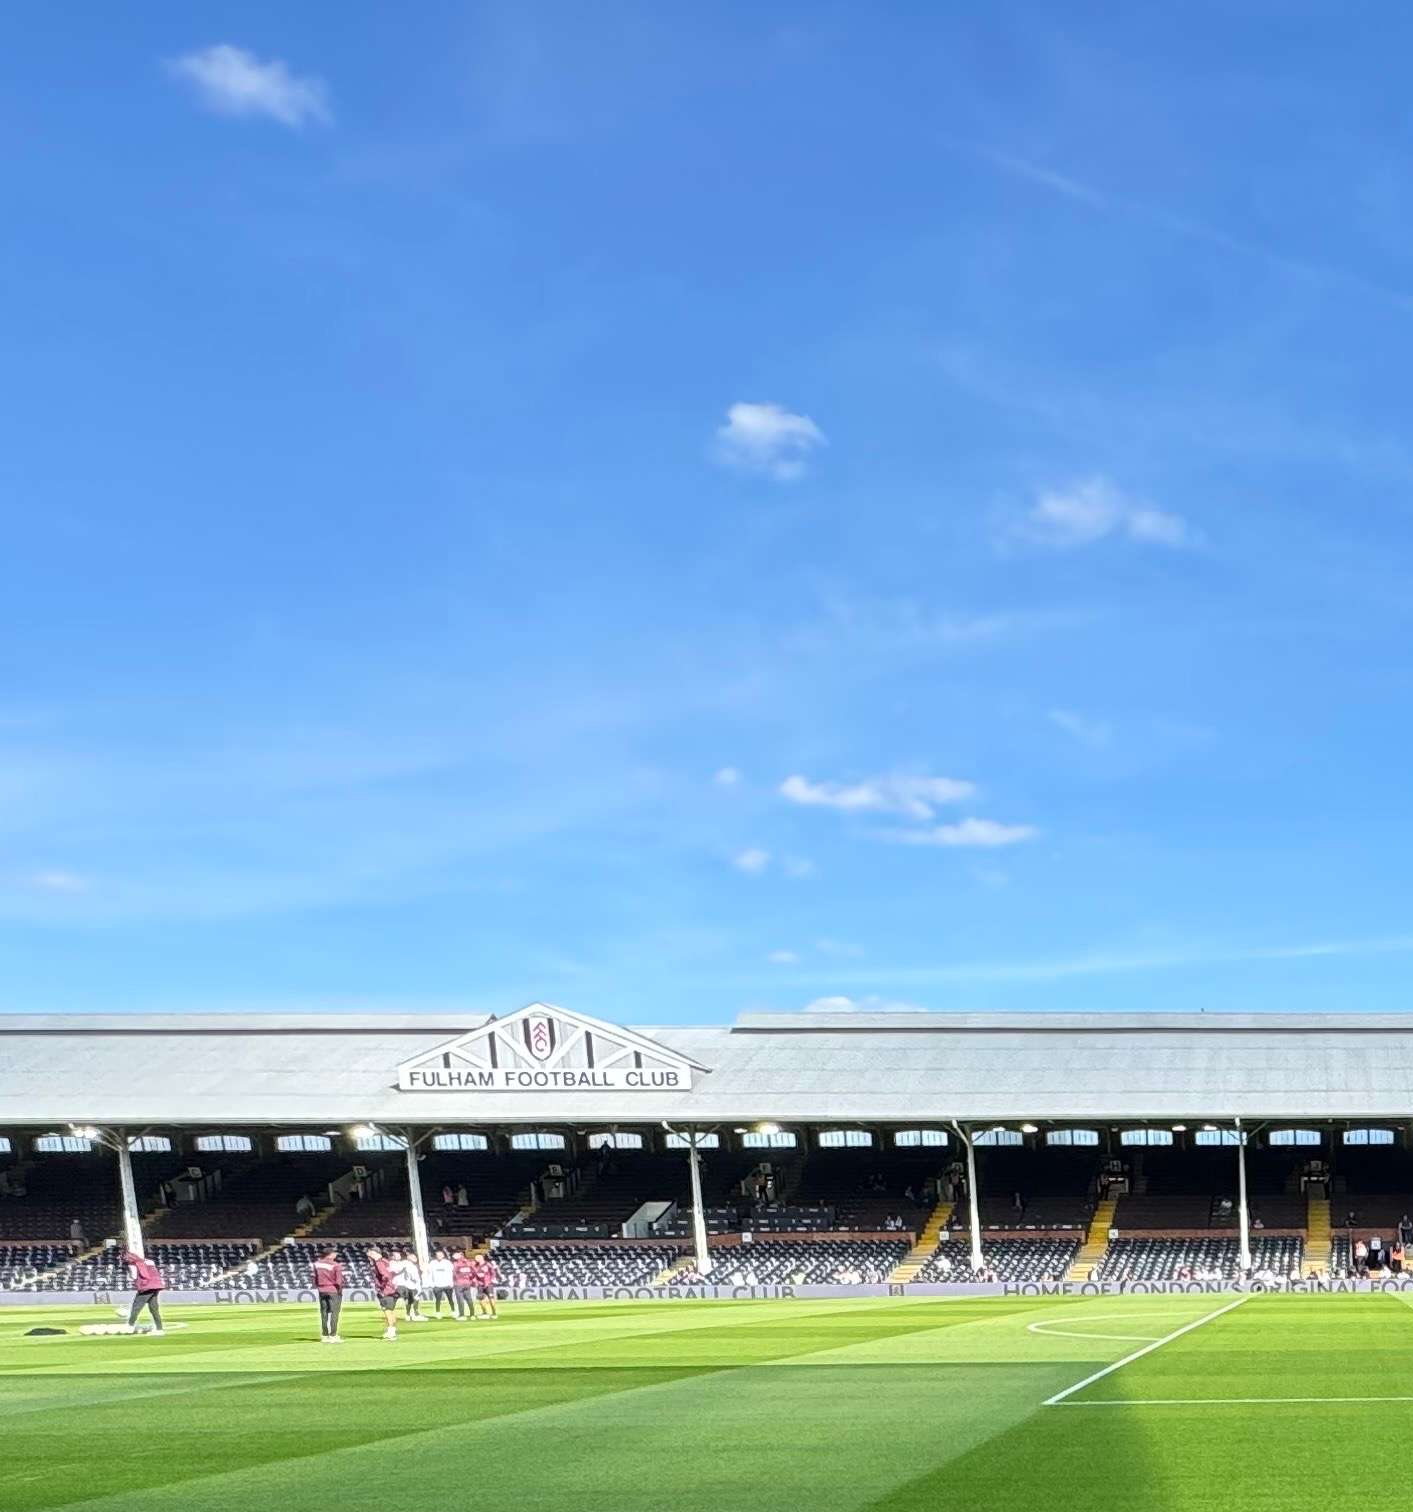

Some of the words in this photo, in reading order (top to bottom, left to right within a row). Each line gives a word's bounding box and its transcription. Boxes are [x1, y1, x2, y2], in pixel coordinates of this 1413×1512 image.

[409, 1071, 494, 1087] FULHAM
[505, 1071, 615, 1087] FOOTBALL
[625, 1071, 679, 1087] CLUB
[732, 1285, 796, 1299] CLUB
[1004, 1283, 1073, 1296] HOME
[215, 1290, 289, 1303] HOME
